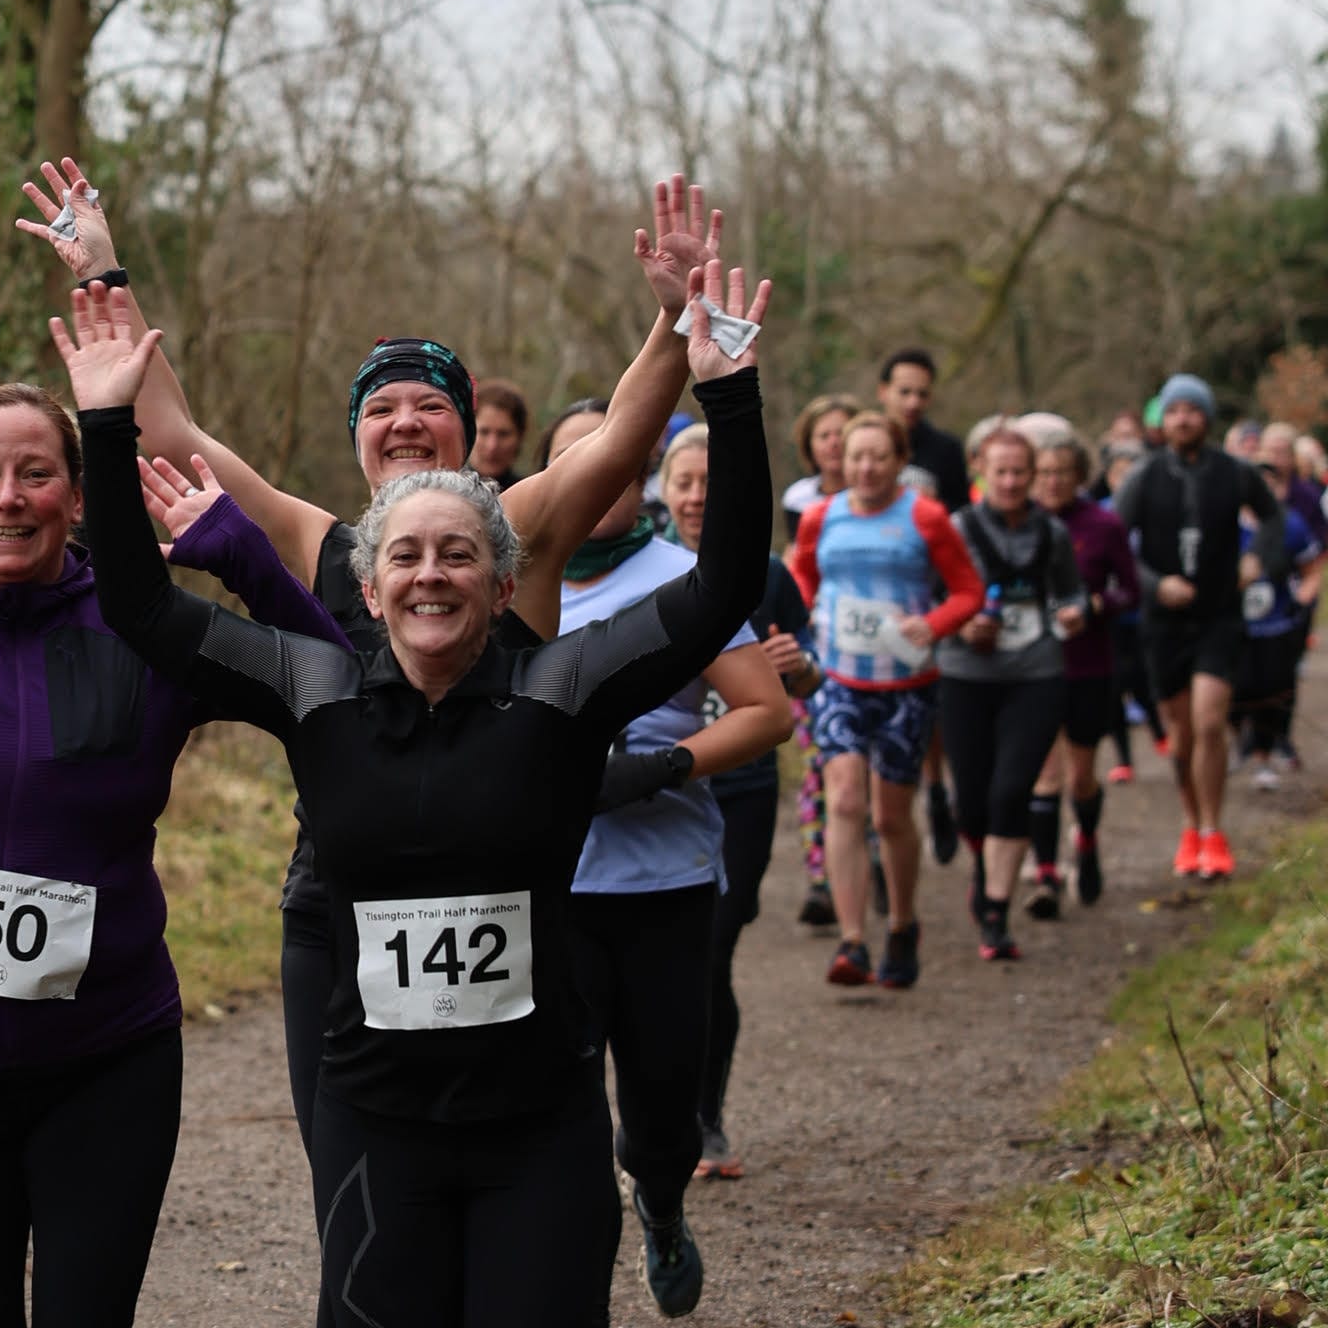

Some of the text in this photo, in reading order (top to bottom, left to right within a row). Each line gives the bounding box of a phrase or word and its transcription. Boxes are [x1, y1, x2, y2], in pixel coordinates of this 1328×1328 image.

[16, 886, 37, 898] Half
[39, 889, 87, 906] Marathon
[365, 903, 521, 922] Tissington Trail Half Marathon
[385, 923, 510, 988] 142
